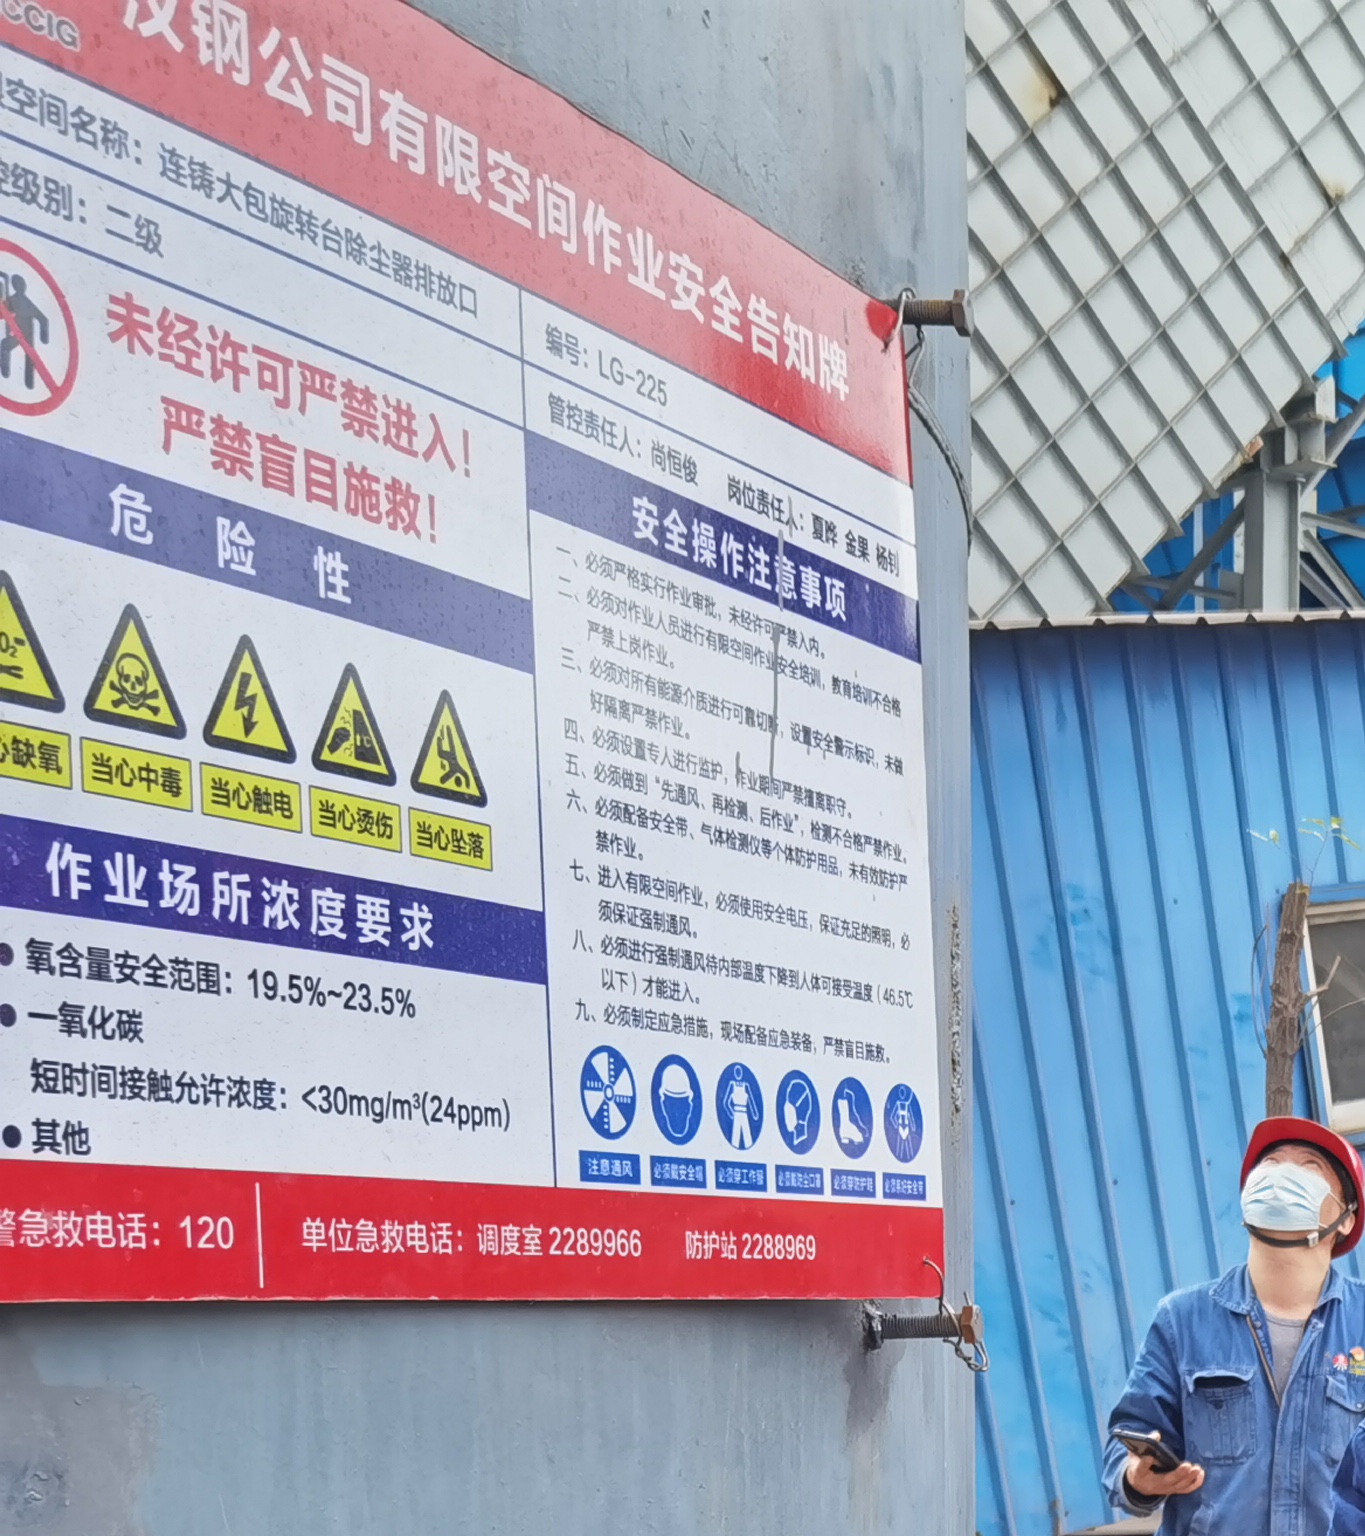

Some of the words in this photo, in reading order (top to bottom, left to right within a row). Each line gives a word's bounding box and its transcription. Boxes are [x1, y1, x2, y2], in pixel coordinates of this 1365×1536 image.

[0, 71, 478, 318] 空间名称：连铸大包旋转台除尘器排放口
[107, 292, 471, 478] 未经许可严禁进入！
[160, 396, 437, 543] 严禁盲目施救！
[108, 483, 352, 604] 危险性
[632, 496, 847, 622] 安全操作注意事项
[586, 620, 675, 670] 严禁上岗作业。
[91, 752, 183, 798] 当心中毒
[210, 777, 294, 820] 当心触电
[318, 801, 394, 841] 当心烫伤
[416, 821, 485, 861] 当心坠落
[595, 830, 644, 862] 禁作业。
[46, 841, 434, 951] 作业场所浓度要求
[598, 899, 697, 938] 须保证强制通风。
[27, 1000, 145, 1043] 一氧化碳
[32, 1118, 92, 1156] 其他
[588, 1157, 633, 1178] 注意通风
[548, 1227, 642, 1257] 2289966
[685, 1230, 738, 1260] 防护站
[741, 1233, 817, 1261] 2288969
